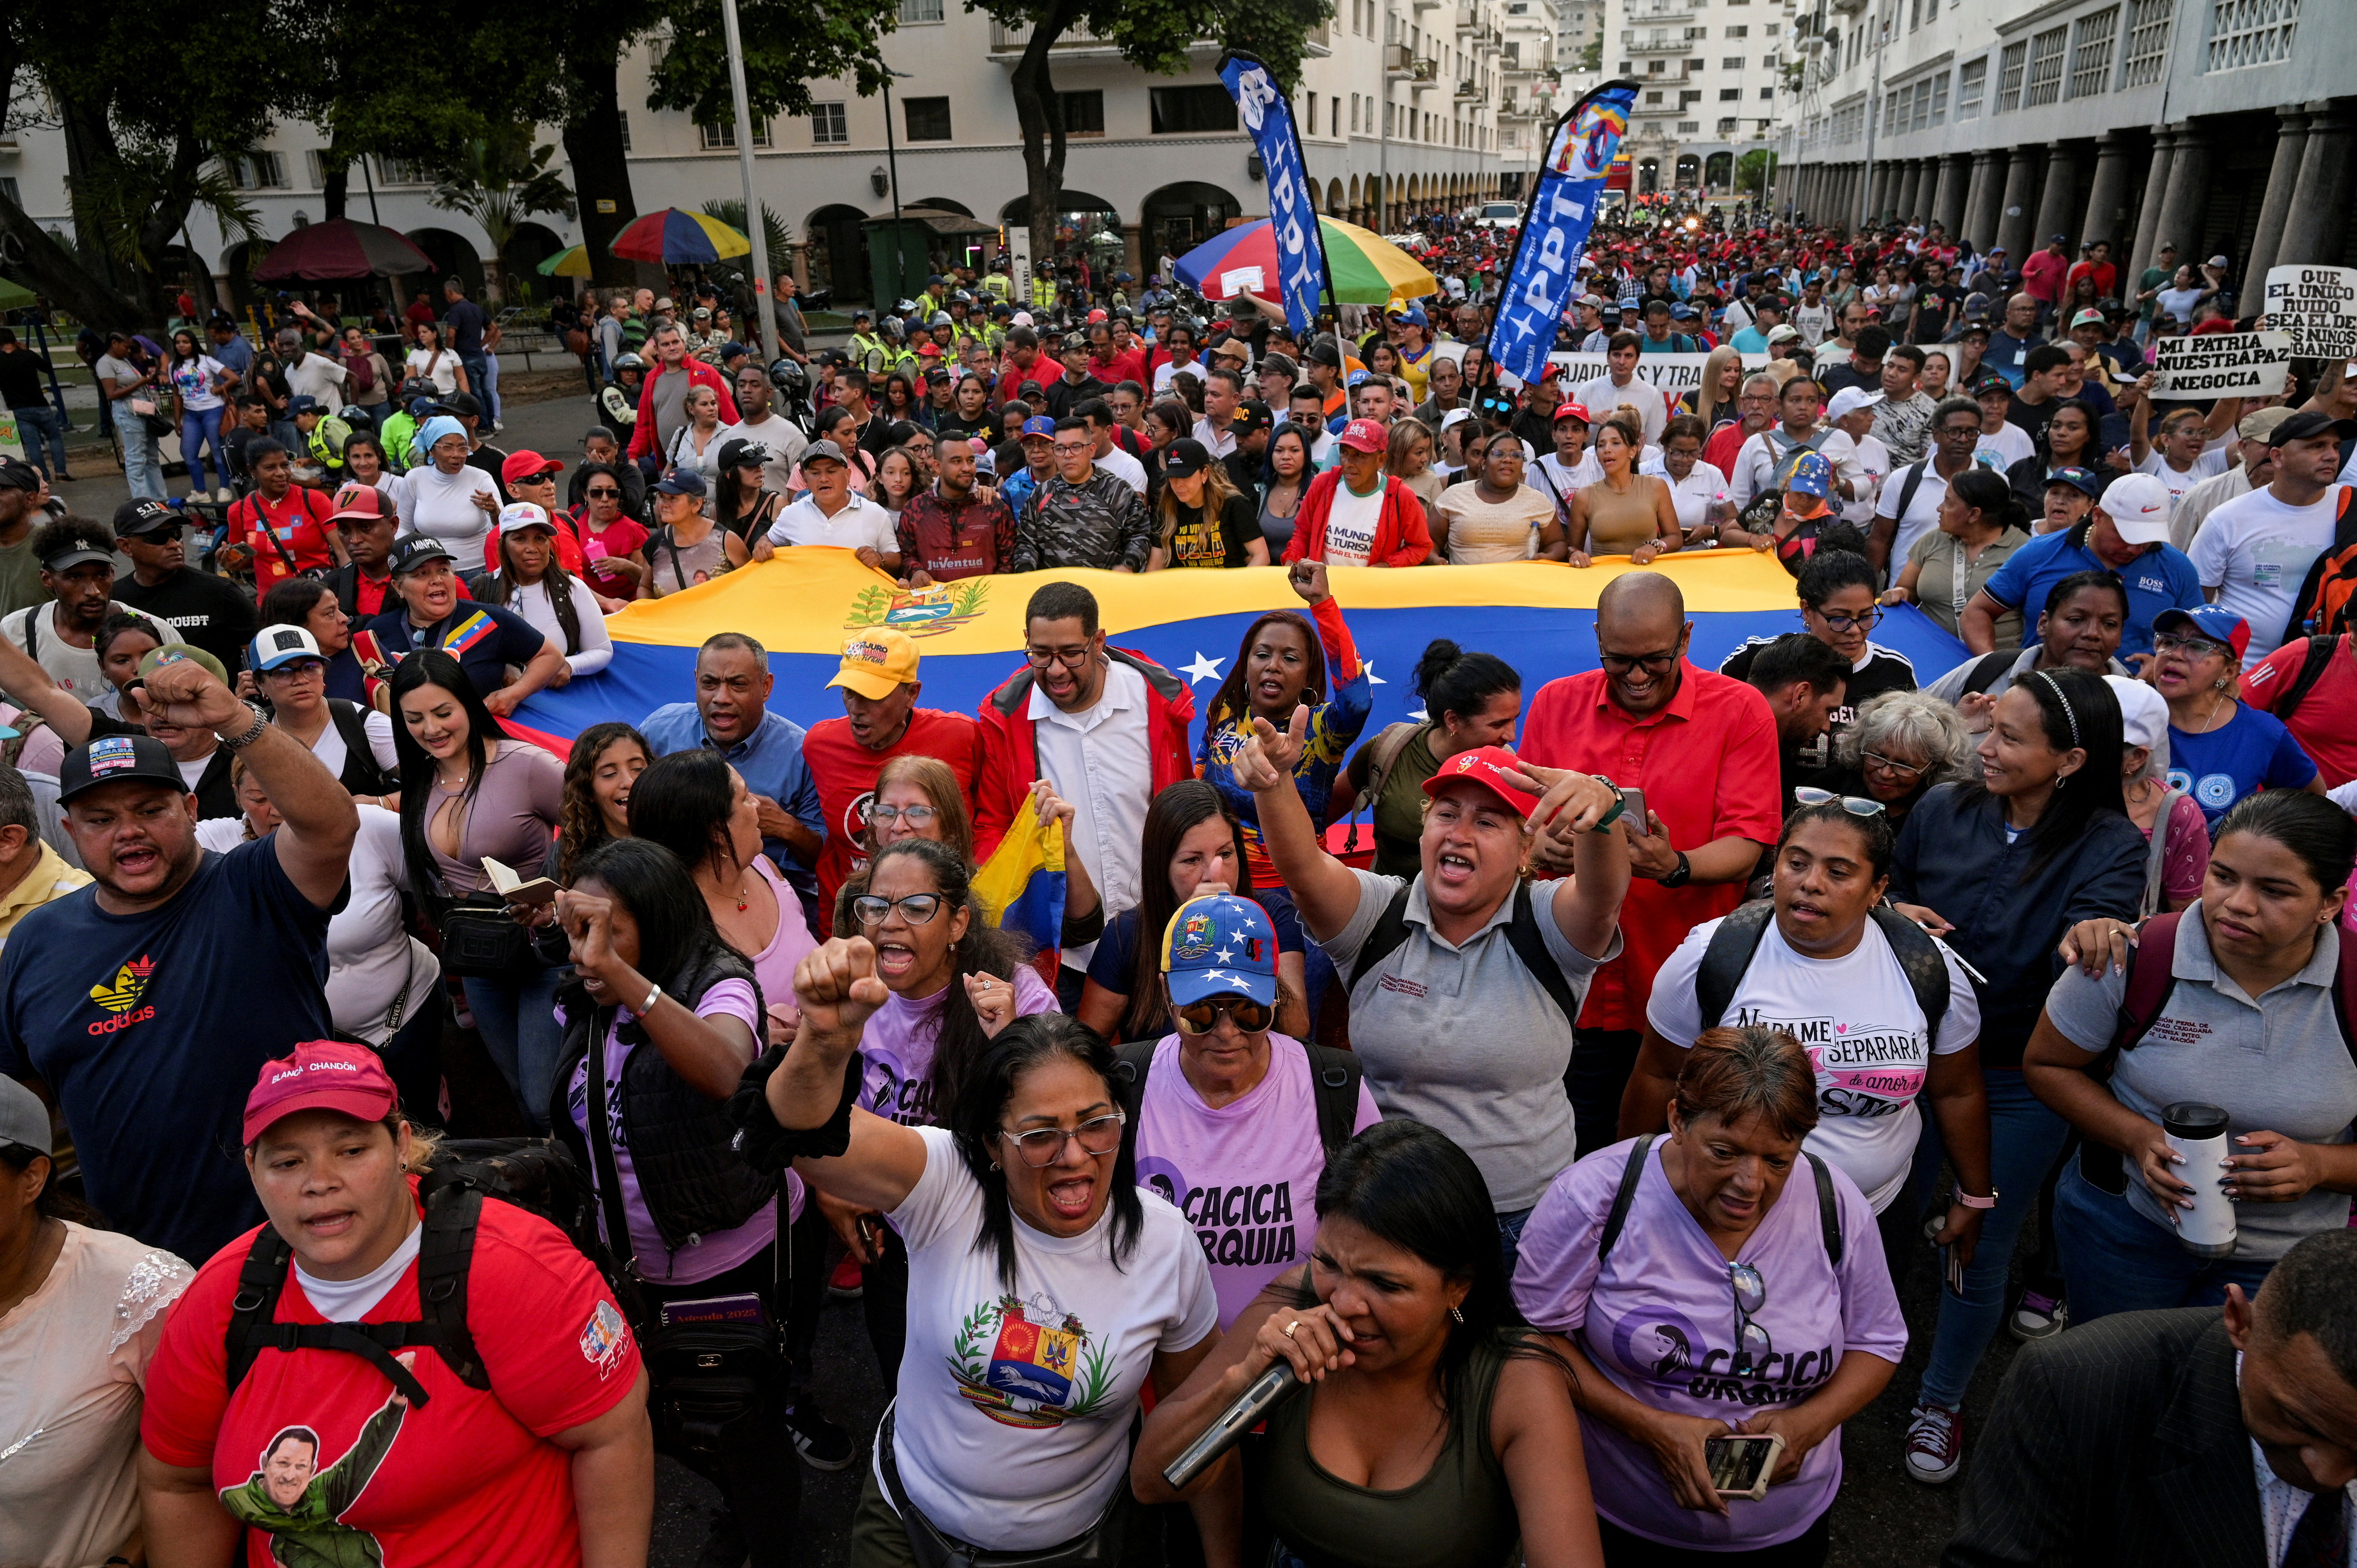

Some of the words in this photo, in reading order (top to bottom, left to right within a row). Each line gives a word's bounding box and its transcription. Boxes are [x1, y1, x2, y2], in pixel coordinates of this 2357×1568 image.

[1273, 165, 1313, 293] PPT
[1524, 182, 1585, 316] PPT
[2301, 270, 2341, 285] QUE
[2268, 283, 2295, 298] EL
[2299, 284, 2354, 300] UNICO
[2282, 298, 2341, 313] RUIDO
[2266, 314, 2305, 327] SEA
[2308, 314, 2330, 327] EL
[2333, 315, 2357, 329] DE
[2159, 339, 2183, 354] MI
[2190, 335, 2262, 352] PATRIA
[2290, 343, 2353, 357] GANDO
[1652, 366, 1664, 386] Y
[2170, 371, 2261, 390] NEGOCIA
[136, 501, 160, 517] 5.11
[1189, 523, 1203, 534] VIV
[1334, 526, 1375, 543] MUNDI
[1333, 538, 1373, 553] TURISM
[2140, 576, 2163, 589] BOSS
[279, 633, 299, 643] VEN
[90, 748, 135, 758] PLENARIA
[1245, 937, 1263, 962] 4F
[88, 1005, 155, 1035] adidas
[2175, 1025, 2213, 1034] CIUDADANA
[1829, 1032, 1922, 1063] SEPARARÁ
[1849, 1074, 1863, 1086] de
[1866, 1076, 1909, 1091] amor
[1184, 1181, 1293, 1227] CACICA
[1195, 1224, 1296, 1268] RQUIA
[677, 1313, 724, 1324] Agenda
[726, 1308, 756, 1318] 2025
